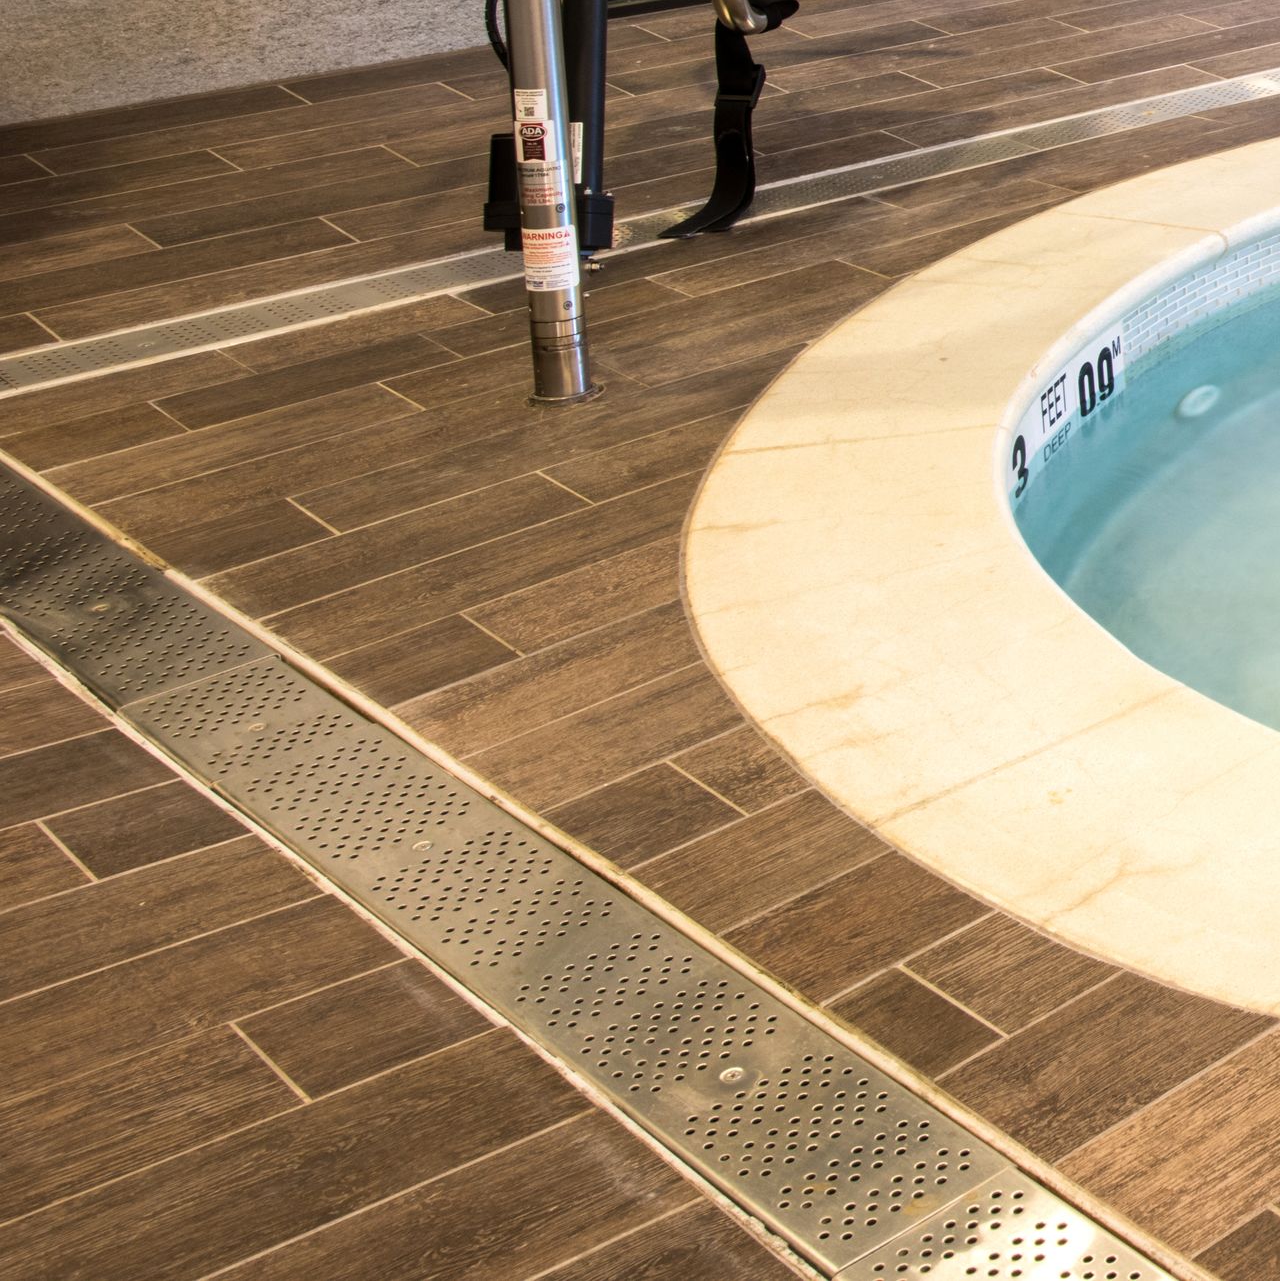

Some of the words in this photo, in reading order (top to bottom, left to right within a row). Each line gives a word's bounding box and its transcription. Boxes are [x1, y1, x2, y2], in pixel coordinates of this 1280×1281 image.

[521, 127, 543, 136] ADA
[1012, 434, 1029, 499] 3
[1040, 372, 1067, 434] FEET
[1043, 421, 1072, 463] DEEP
